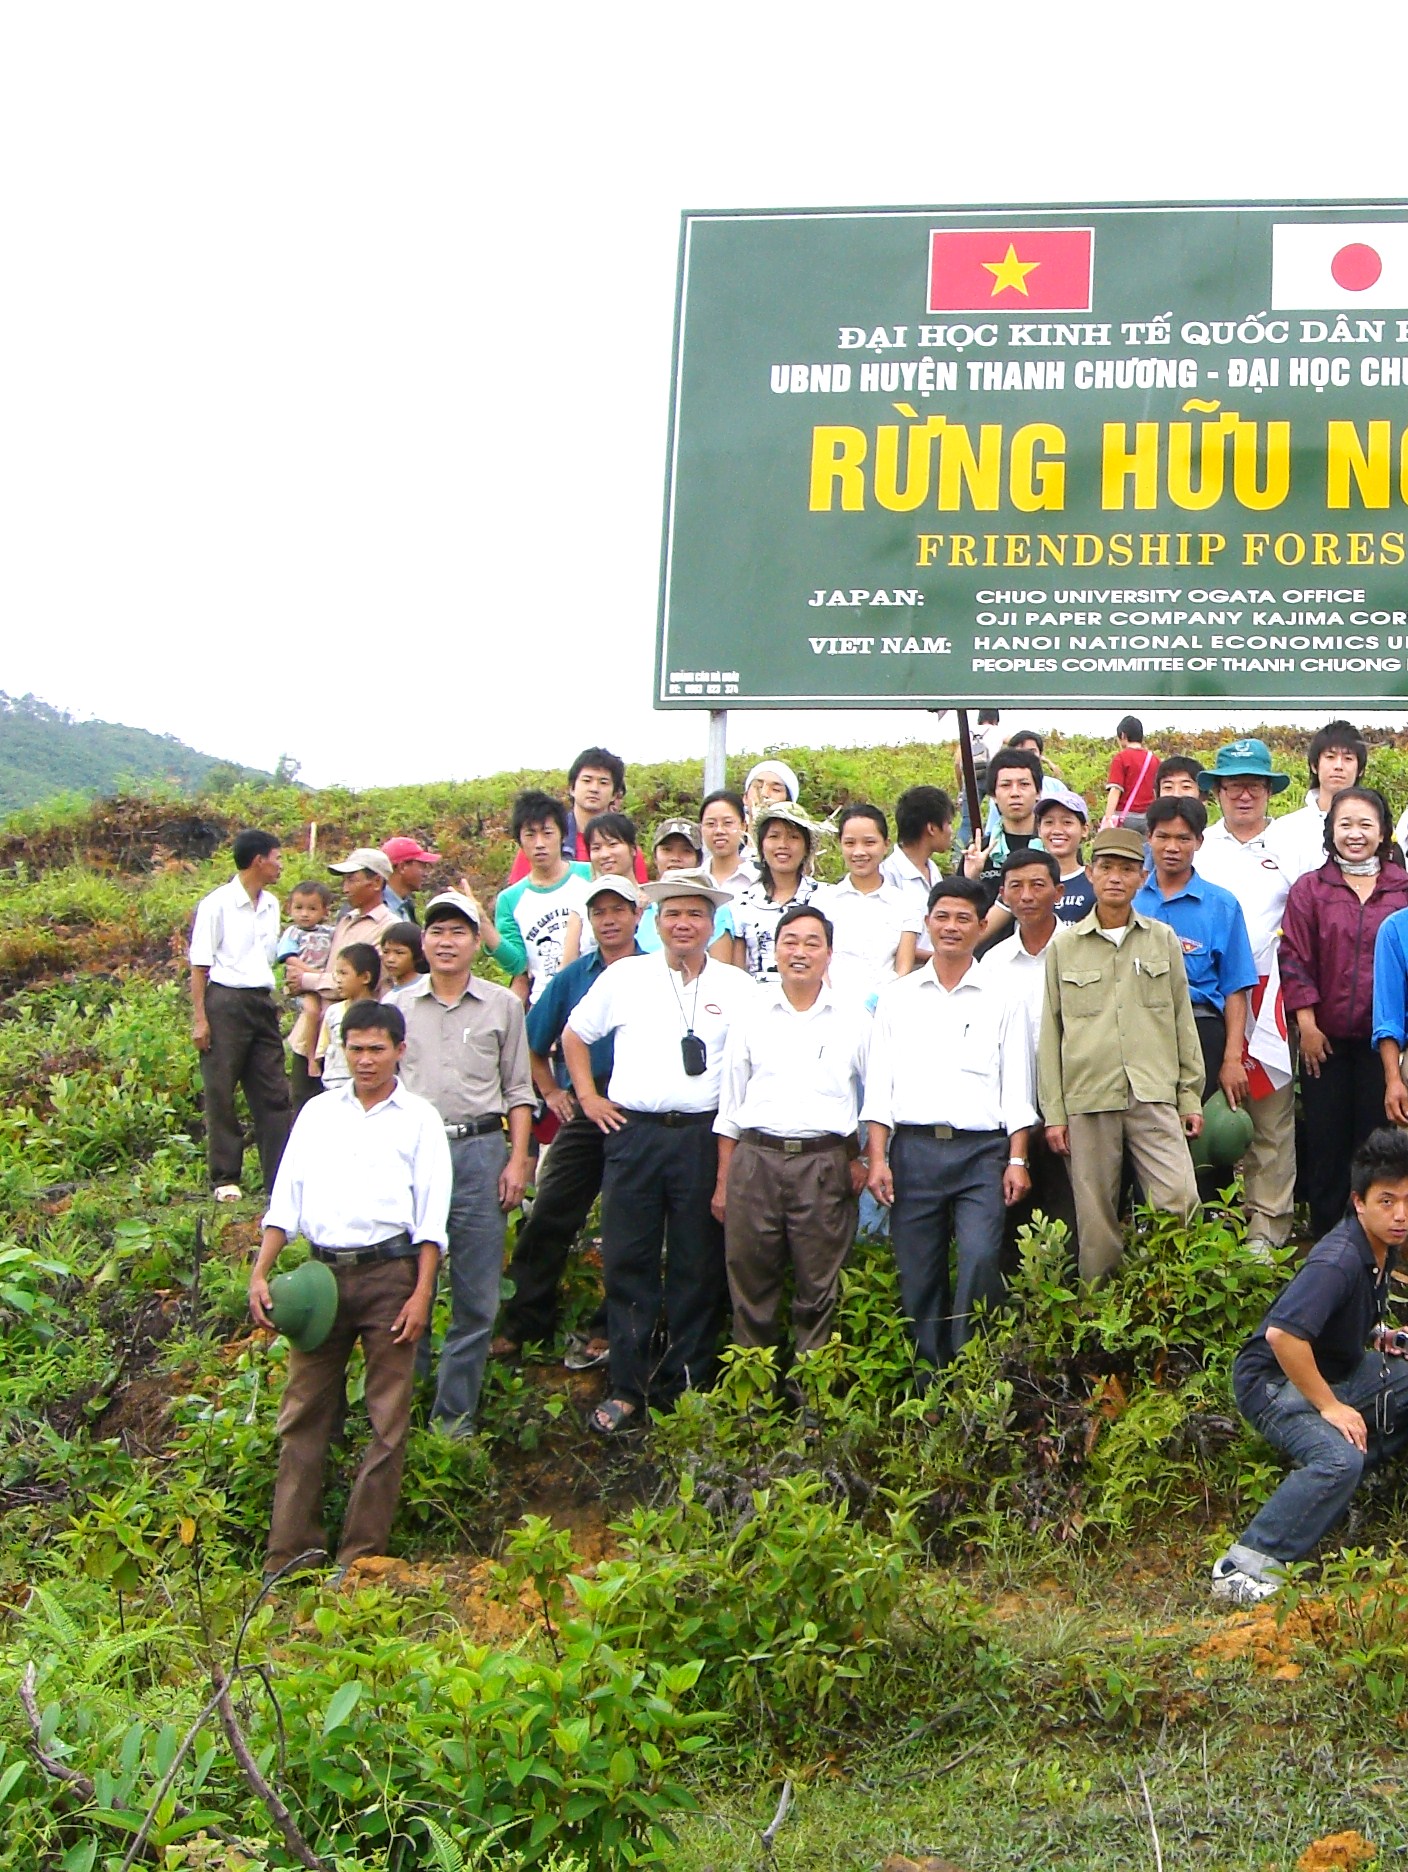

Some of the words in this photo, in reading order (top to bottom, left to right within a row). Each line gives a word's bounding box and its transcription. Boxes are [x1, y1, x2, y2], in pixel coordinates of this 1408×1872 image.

[838, 326, 907, 354] ĐẠI
[918, 324, 998, 352] HỌC
[1008, 324, 1111, 345] KINH
[1121, 312, 1172, 344] TẾ
[1181, 311, 1289, 345] QUỐC
[1300, 314, 1385, 342] DÂN
[771, 364, 851, 393] UBND
[860, 356, 957, 397] HUYỆN
[967, 361, 1065, 390] THANH
[1075, 357, 1197, 389] CHƯƠNG
[1228, 358, 1279, 393] ĐẠI
[1290, 357, 1350, 392] HỌC
[809, 403, 1065, 512] RỪNG
[1102, 399, 1290, 510] HỮU
[917, 534, 1225, 566] FRIENDSHIP
[809, 590, 924, 606] JAPAN:
[976, 591, 1046, 603] CHUO
[1054, 590, 1182, 603] UNIVERSITY
[1188, 590, 1275, 603] OGATA
[1283, 590, 1365, 603] OFFICE
[976, 613, 1017, 625] OJI
[1026, 612, 1101, 625] PAPER
[1110, 612, 1242, 625] COMPANY
[1253, 612, 1344, 625] KAJIMA
[809, 638, 874, 655] VIET
[881, 637, 951, 653] NAM:
[975, 637, 1060, 650] HANOI
[1070, 636, 1202, 649] NATIONAL
[1212, 636, 1379, 649] ECONOMICS
[973, 659, 1057, 671] PEOPLES
[1062, 658, 1183, 671] COMMITTEE
[1187, 658, 1217, 670] OF
[1222, 658, 1294, 671] THANH
[1301, 658, 1401, 671] CHUONG
